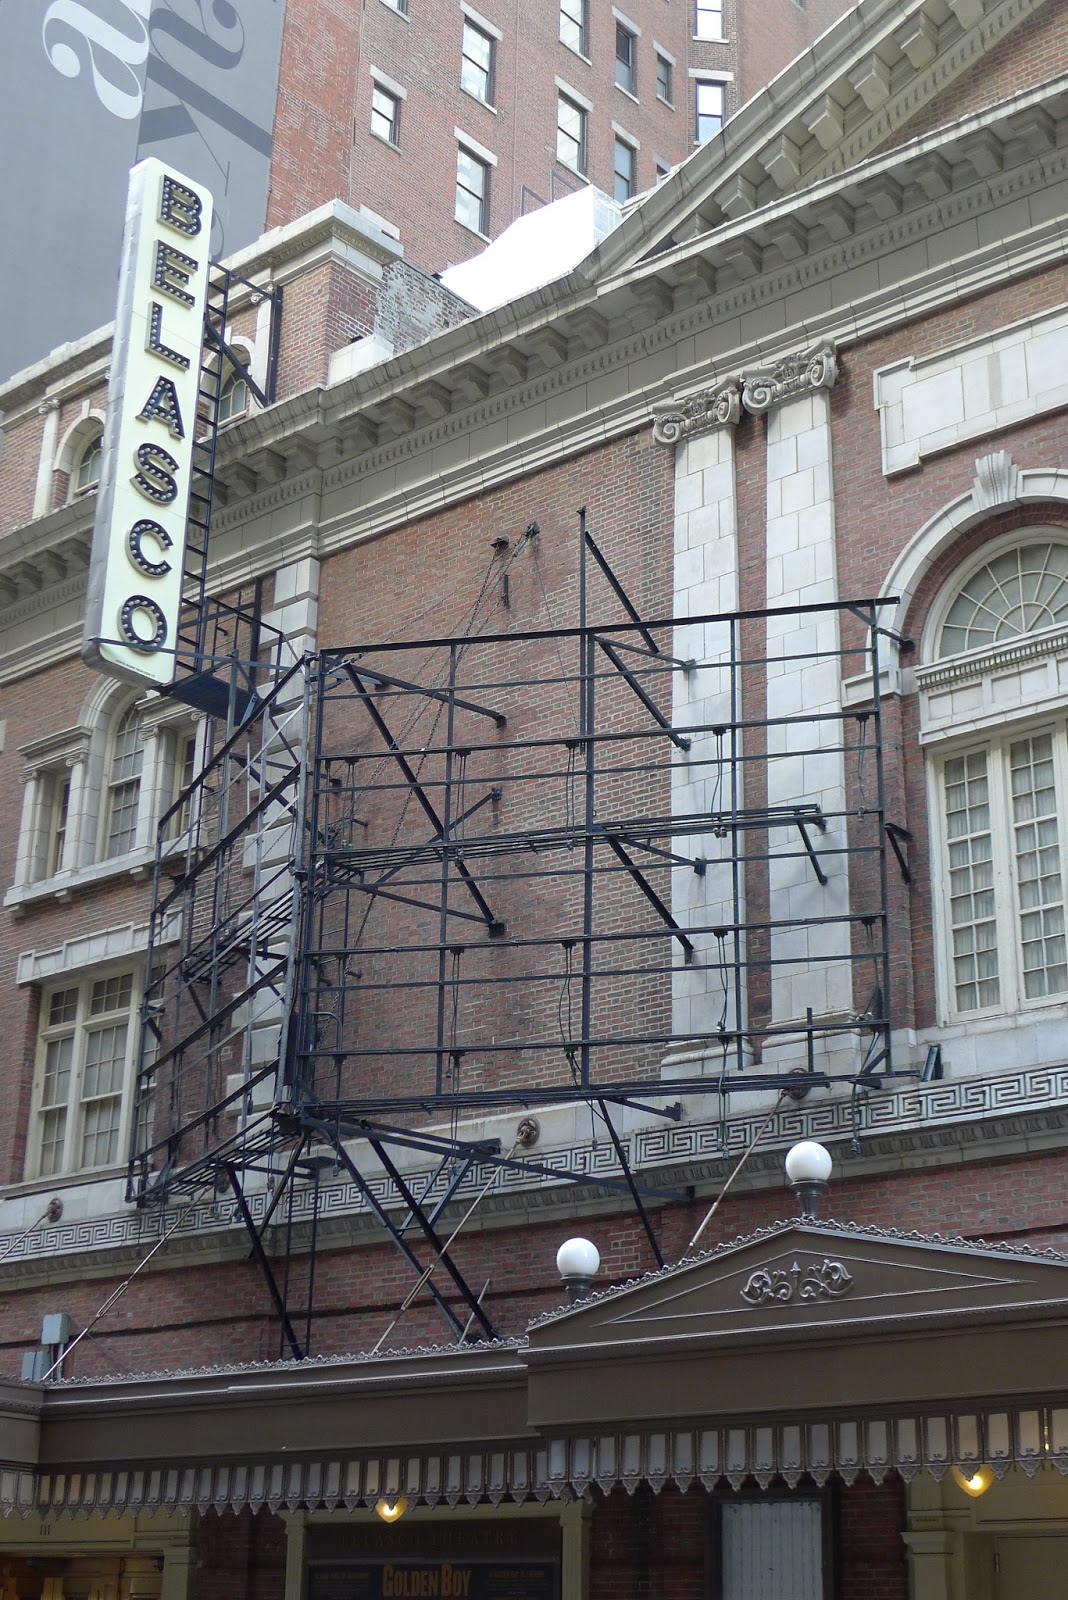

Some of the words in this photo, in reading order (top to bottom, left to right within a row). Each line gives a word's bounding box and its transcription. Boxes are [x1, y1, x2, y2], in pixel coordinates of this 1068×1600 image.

[117, 174, 202, 655] BELASCO
[383, 1564, 439, 1597] GOLDEN
[441, 1563, 472, 1597] BOY
